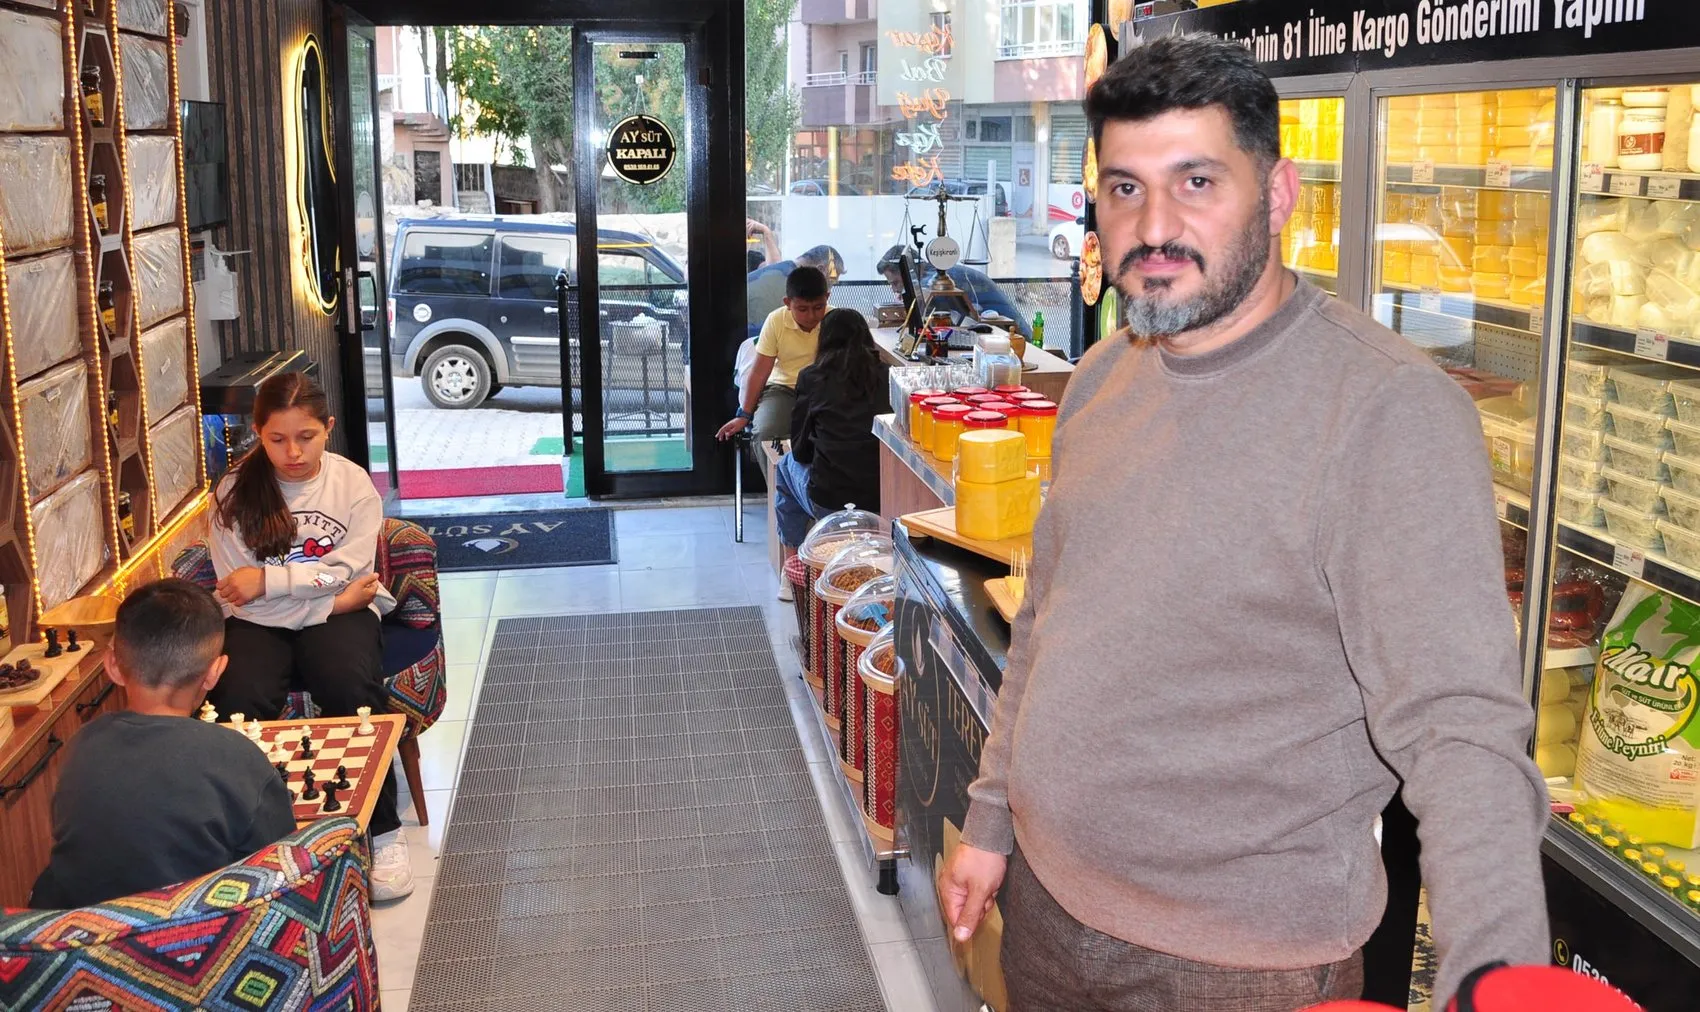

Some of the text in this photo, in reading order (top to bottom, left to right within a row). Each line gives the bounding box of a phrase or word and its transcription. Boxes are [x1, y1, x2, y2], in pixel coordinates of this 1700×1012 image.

[1283, 19, 1301, 61] 81
[1308, 8, 1347, 58] İline
[1352, 9, 1409, 59] Kargo
[620, 130, 662, 143] AY SÜT
[615, 148, 667, 159] KAPALI
[500, 521, 567, 536] AY
[1638, 695, 1652, 706] SÜT
[1614, 735, 1667, 760] Peyniri
